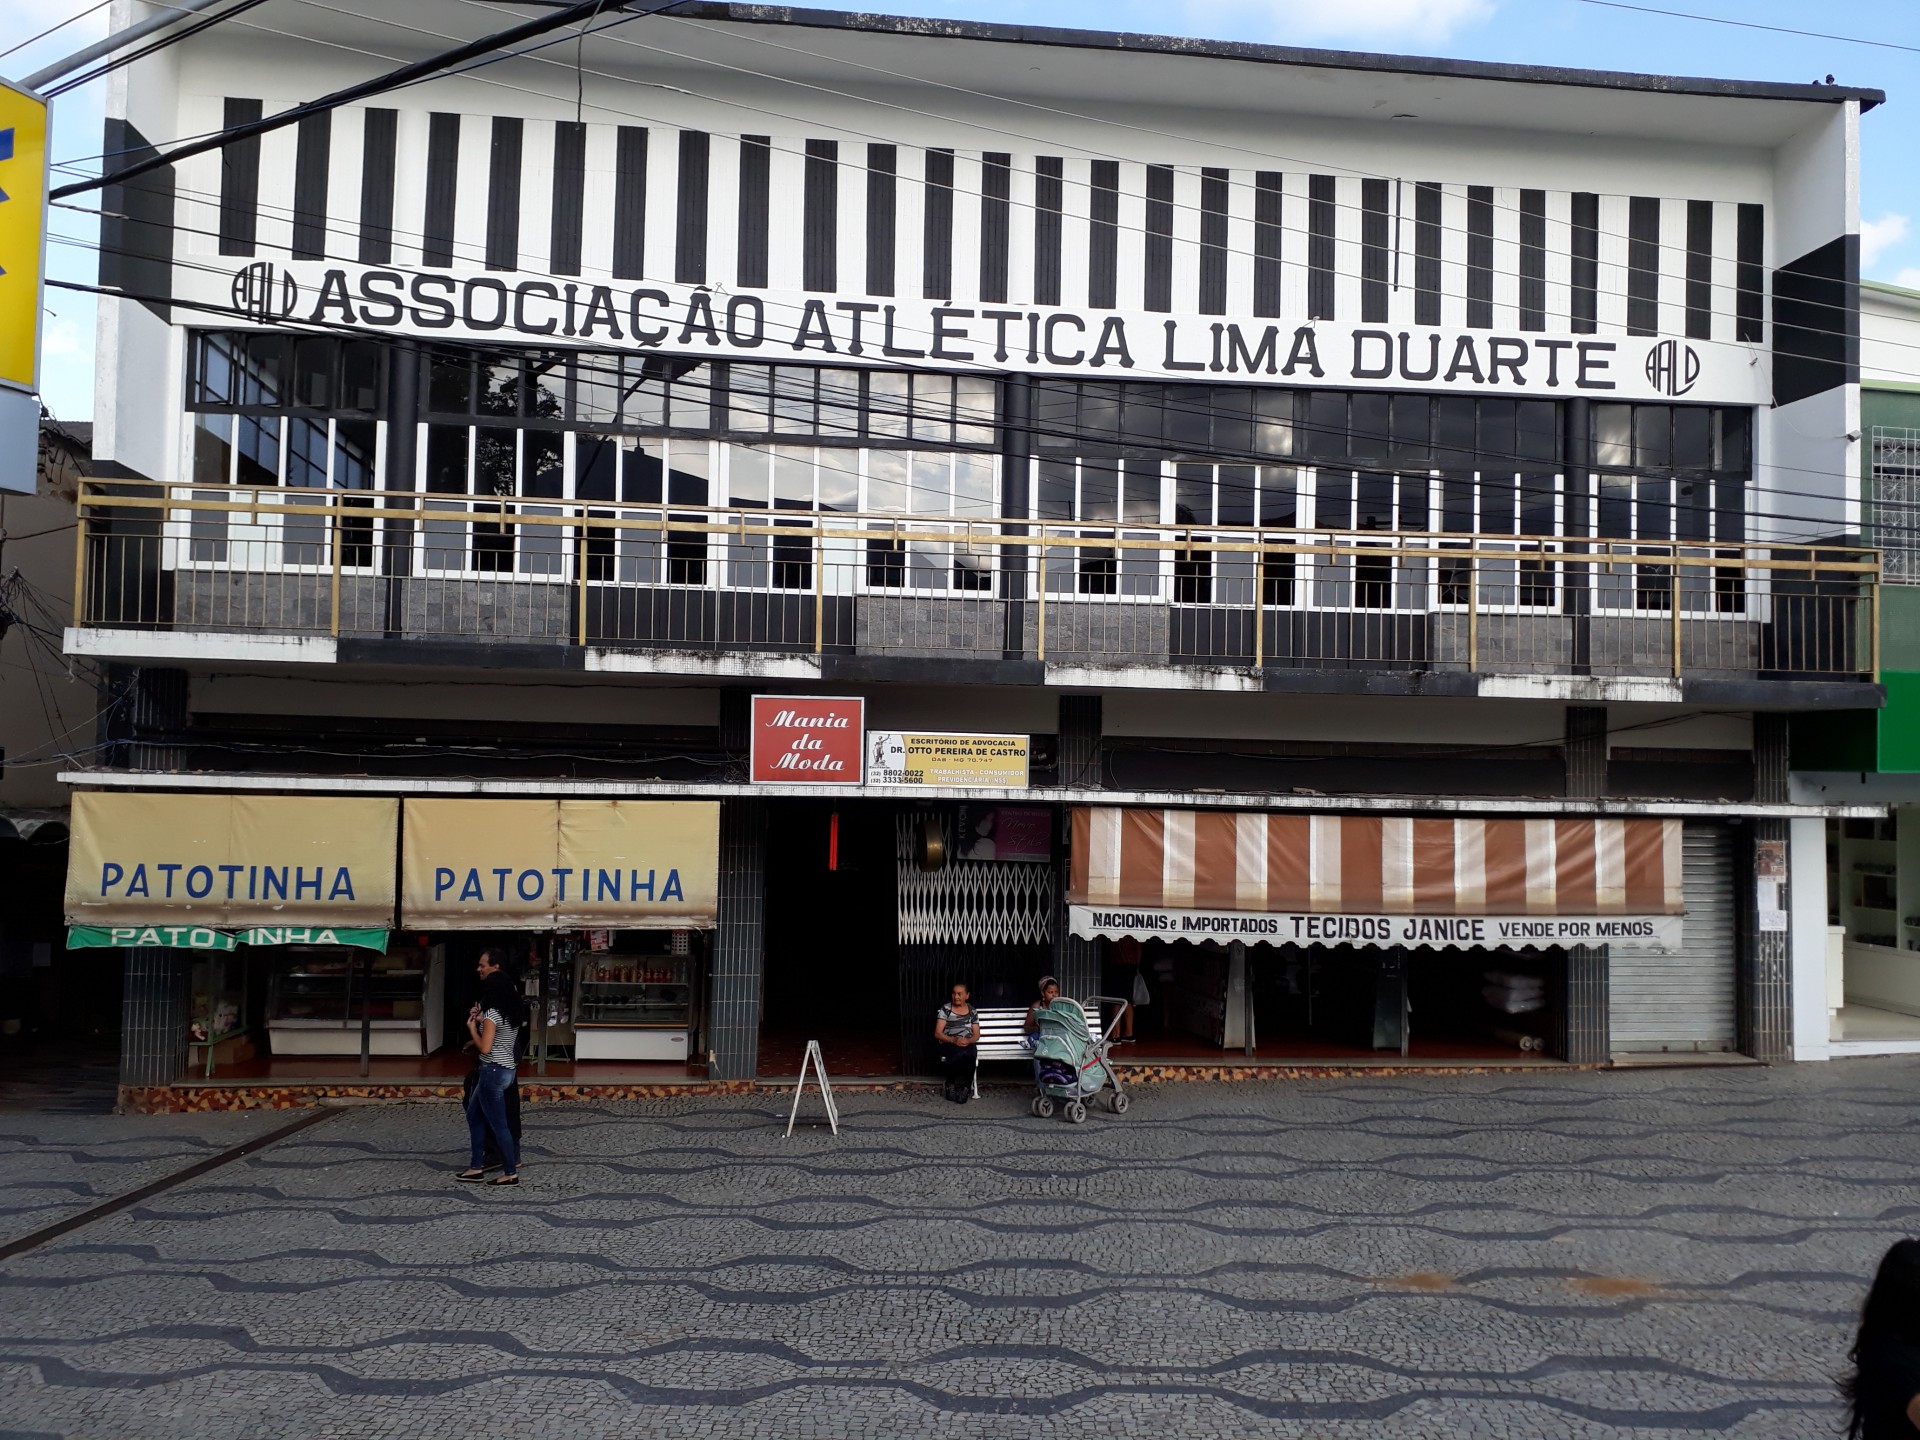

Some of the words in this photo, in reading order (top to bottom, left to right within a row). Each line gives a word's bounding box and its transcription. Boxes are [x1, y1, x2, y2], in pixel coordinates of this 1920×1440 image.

[309, 268, 764, 348] ASSOCIAÇÃO
[791, 299, 1135, 368] ATLÉTICA
[1162, 319, 1325, 378] LIMA
[1350, 329, 1616, 389] DUARTE
[765, 710, 849, 728] Mania
[791, 733, 823, 750] da
[910, 737, 958, 746] ESCRITÓRIO
[972, 739, 1016, 747] ADVOCACIA
[890, 746, 906, 754] DR.
[908, 747, 932, 755] OTTO
[934, 747, 974, 756] PEREIRA
[975, 748, 987, 756] DE
[990, 748, 1026, 757] CASTRO
[770, 752, 845, 771] Moda
[883, 769, 924, 777] 8802-0022
[101, 862, 355, 901] PATOTINHA
[435, 867, 685, 902] PATOTINHA
[1092, 912, 1168, 930] NACIONAIS
[1182, 915, 1278, 934] IMPORTADOS
[1290, 915, 1391, 940] TECIDOS
[1403, 918, 1485, 941] JANICE
[1499, 921, 1554, 938] VENDE
[1558, 921, 1591, 937] POR
[1596, 921, 1654, 937] MENOS
